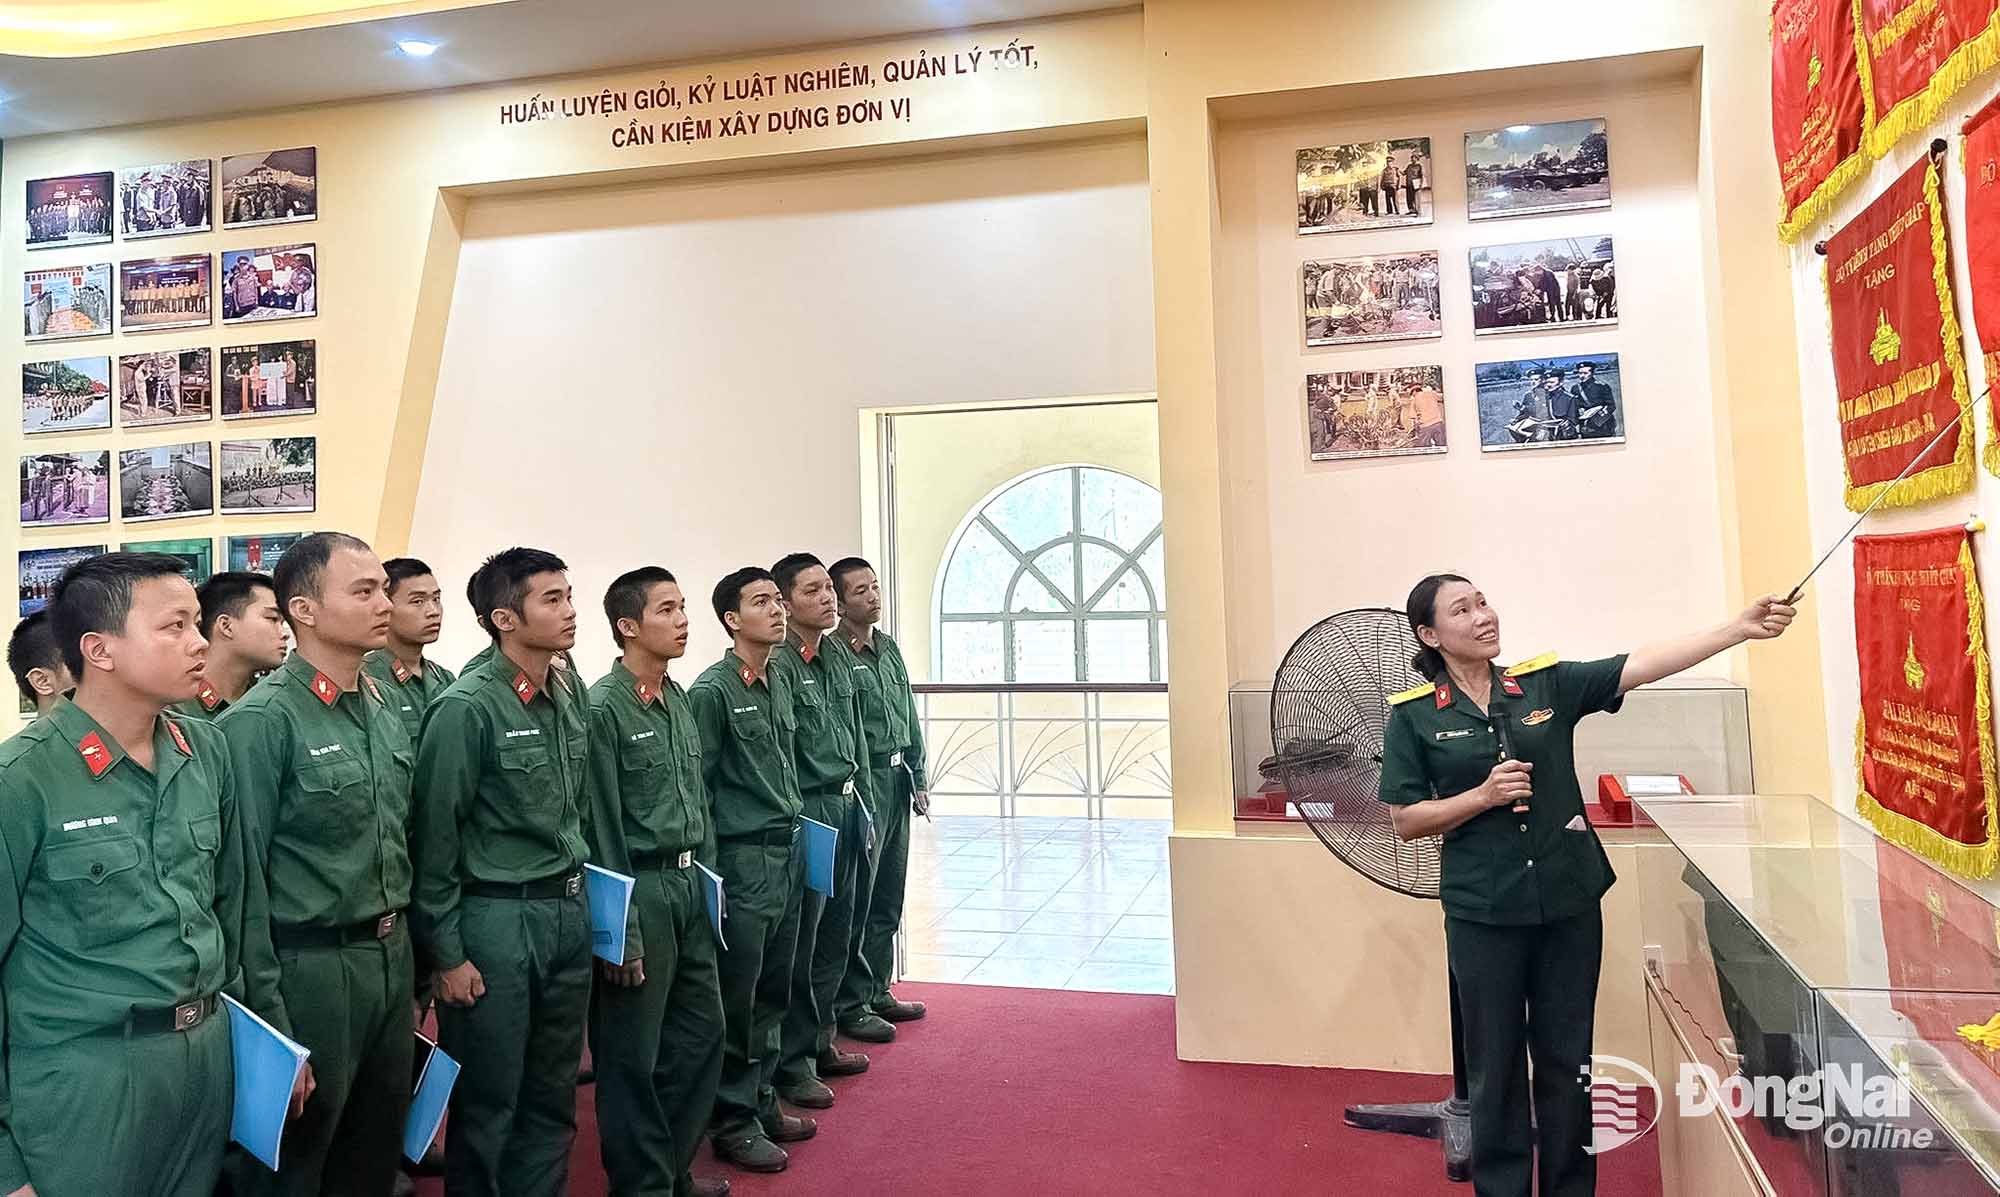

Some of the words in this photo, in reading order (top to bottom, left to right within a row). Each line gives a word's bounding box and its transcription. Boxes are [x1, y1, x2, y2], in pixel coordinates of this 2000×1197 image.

[500, 93, 555, 124] HUẤN
[561, 88, 628, 118] LUYỆN
[634, 79, 682, 110] GIỎI,
[688, 74, 717, 105] KỶ
[723, 72, 778, 101] LUẬT
[784, 61, 877, 94] NGHIÊM,
[883, 49, 946, 83] QUẢN
[954, 45, 983, 75] LÝ
[989, 38, 1039, 71] TỐT,
[611, 118, 655, 148] CẦN
[661, 115, 712, 145] KIỆM
[719, 110, 761, 138] XÂY
[768, 106, 830, 135] DỰNG
[836, 99, 883, 126] ĐƠN
[890, 97, 911, 123] VỊ
